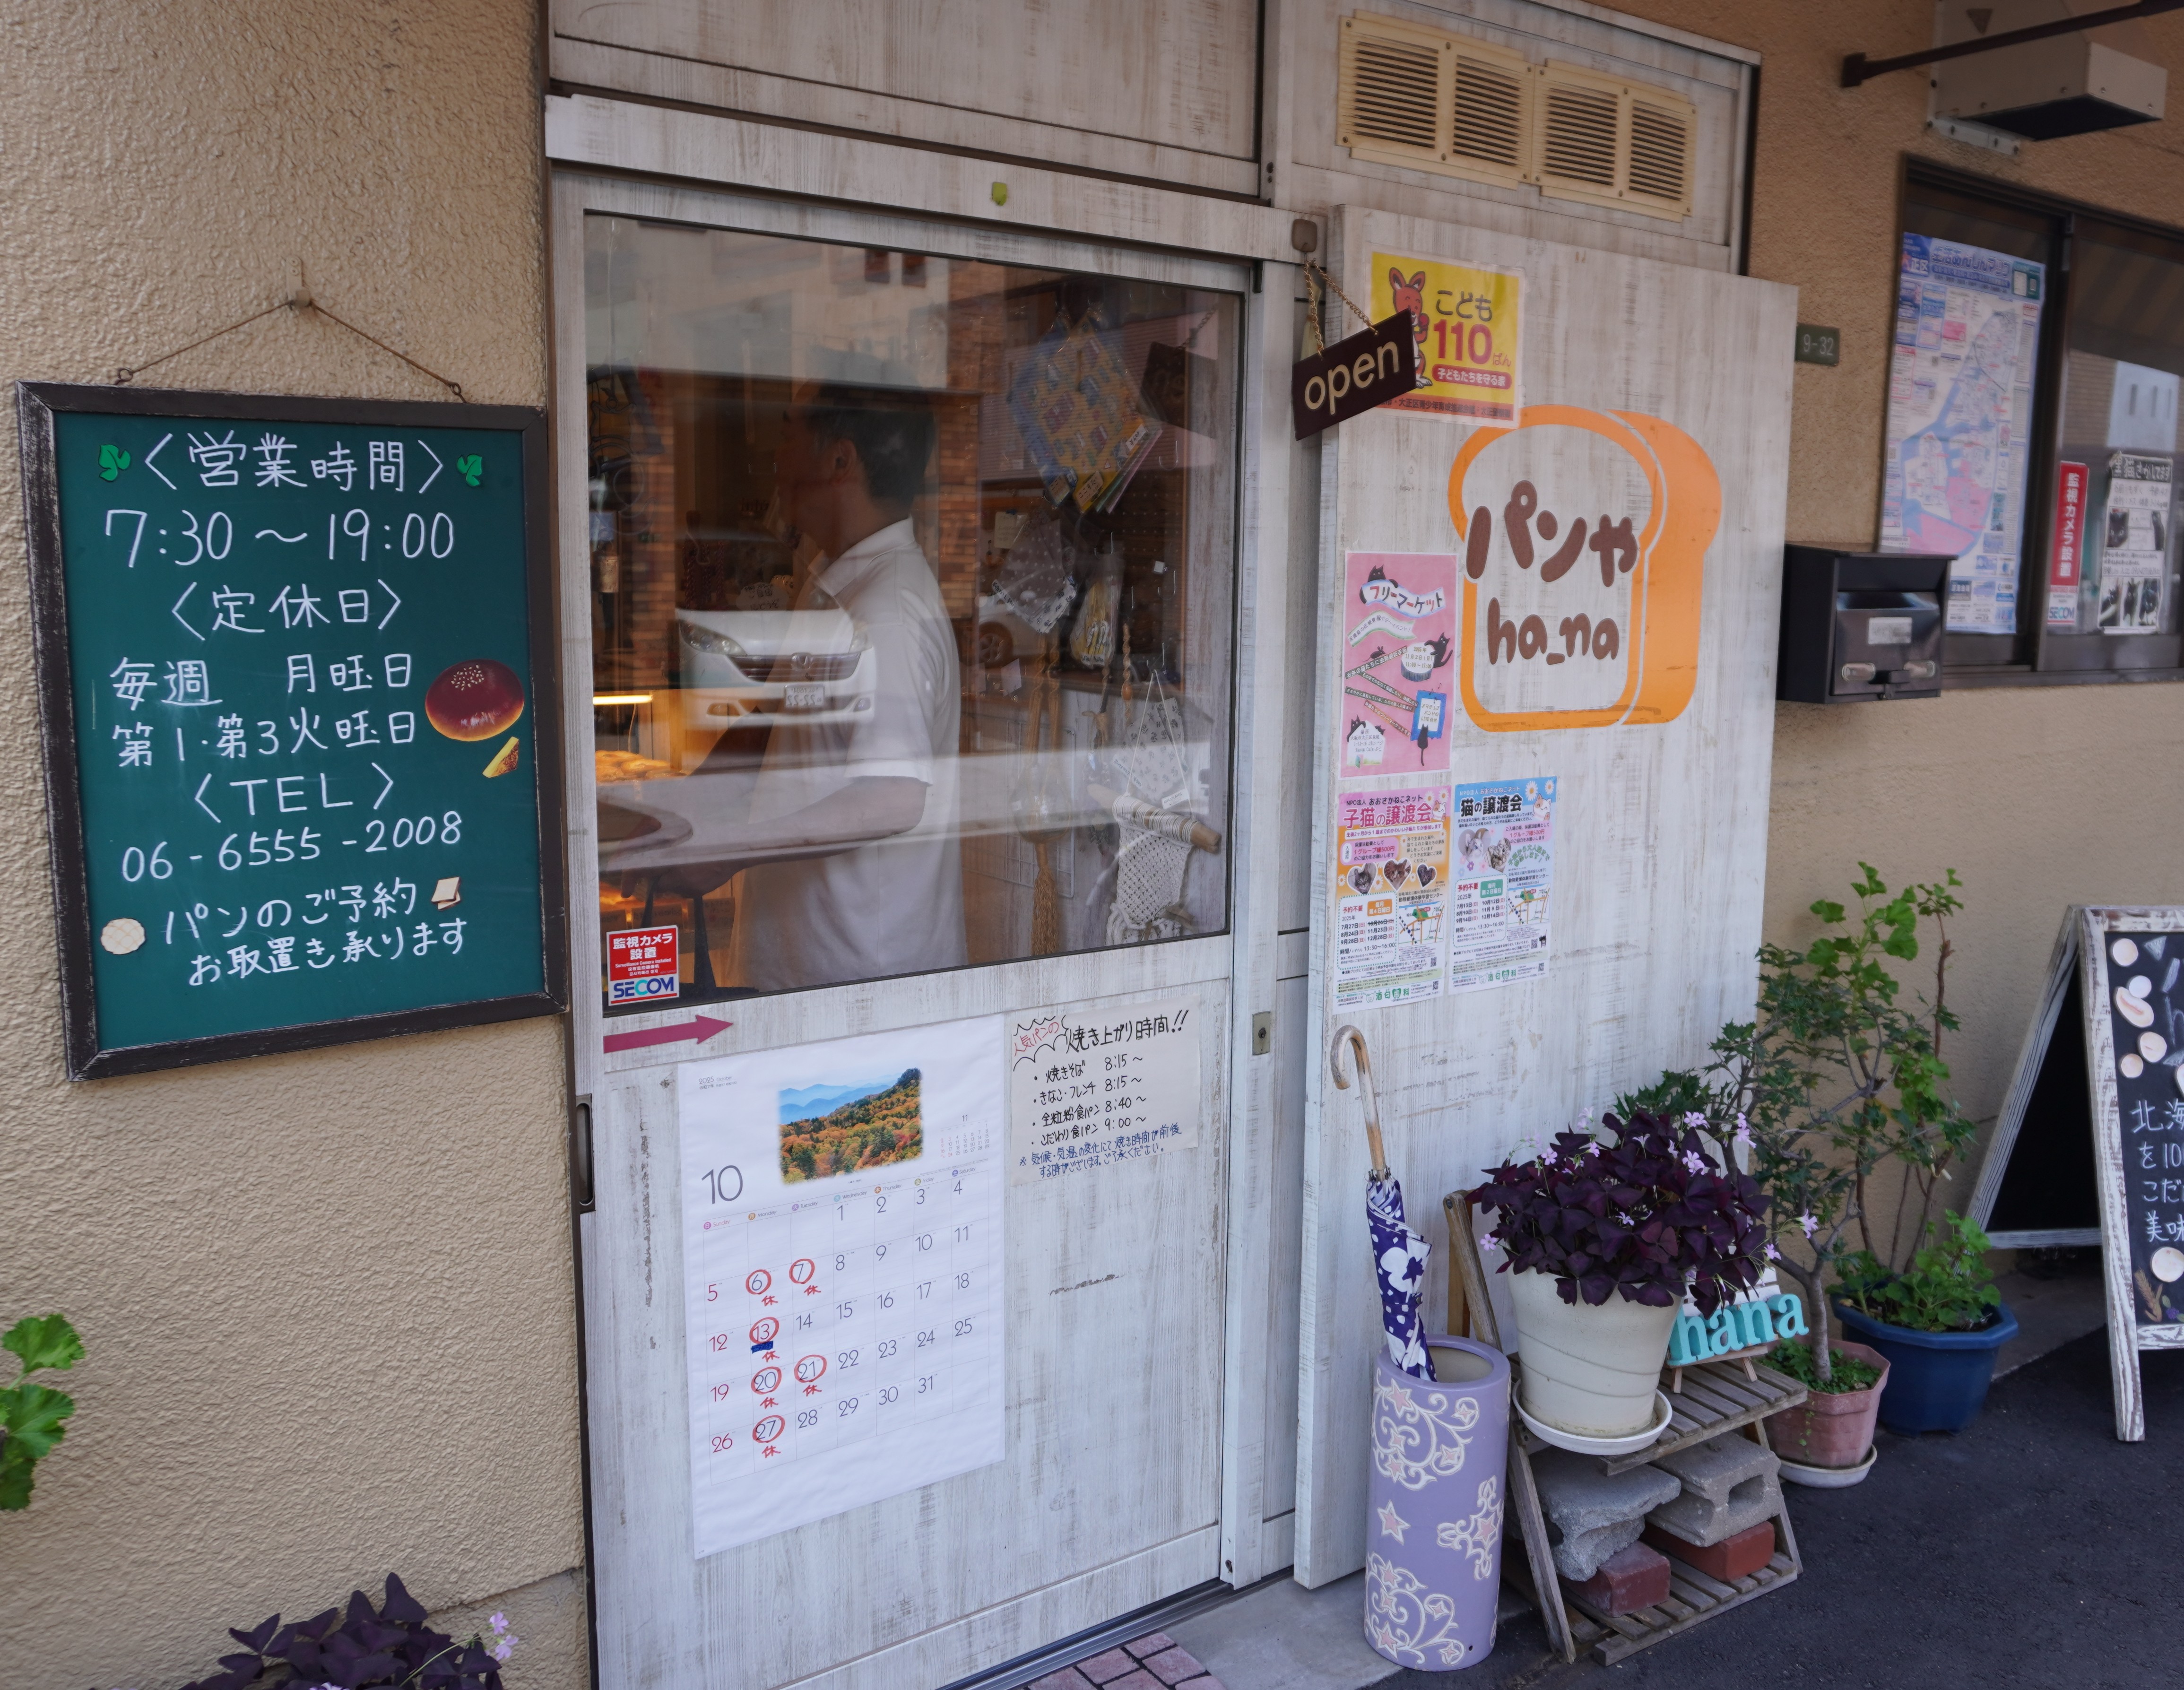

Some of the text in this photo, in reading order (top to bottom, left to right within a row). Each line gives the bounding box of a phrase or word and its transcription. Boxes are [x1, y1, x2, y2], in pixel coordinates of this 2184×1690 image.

[1436, 289, 1492, 322] こども
[1803, 334, 1833, 355] 9-32
[1305, 341, 1399, 415] open
[1438, 368, 1505, 387] 子どもたちを守る家
[1466, 480, 1638, 587] パンや
[2060, 472, 2080, 577] 監視カメラ設置
[1369, 585, 1442, 614] フリーマーケット
[2049, 607, 2075, 619] SECOM
[110, 657, 222, 710] 毎週
[1369, 794, 1423, 806] おおさかねこネット
[1461, 794, 1523, 816] 猫の譲渡会
[1343, 803, 1432, 829] 子猫の譲渡会
[1457, 883, 1479, 892] 予約不要
[166, 877, 416, 944] パンのご予約
[1343, 905, 1363, 913] 予約不要
[190, 918, 467, 986] お取置き承ります
[613, 933, 673, 949] 監視カメラ
[630, 946, 657, 961] 設置
[614, 976, 674, 998] SECOM
[1014, 1022, 1059, 1057] 人気パンの
[699, 1076, 714, 1084] 2025
[702, 1165, 743, 1205] 10
[842, 1190, 867, 1199] Wednesday
[959, 1167, 976, 1175] Saturday
[836, 1180, 962, 1221] 1 2 3 4
[708, 1226, 969, 1301] 5 6 7 8 9 10 11
[762, 1295, 778, 1307] 休
[804, 1285, 821, 1296] 休
[709, 1273, 970, 1352] 12 13 14 15 16 17 18
[1667, 1293, 1810, 1367] hana
[711, 1318, 972, 1402] 19 20 21 22 23 24 25
[762, 1351, 780, 1362] 休
[760, 1397, 779, 1409] 休
[803, 1385, 822, 1397] 休
[712, 1375, 934, 1453] 26 27 28 29 30 31
[762, 1446, 781, 1458] 休
